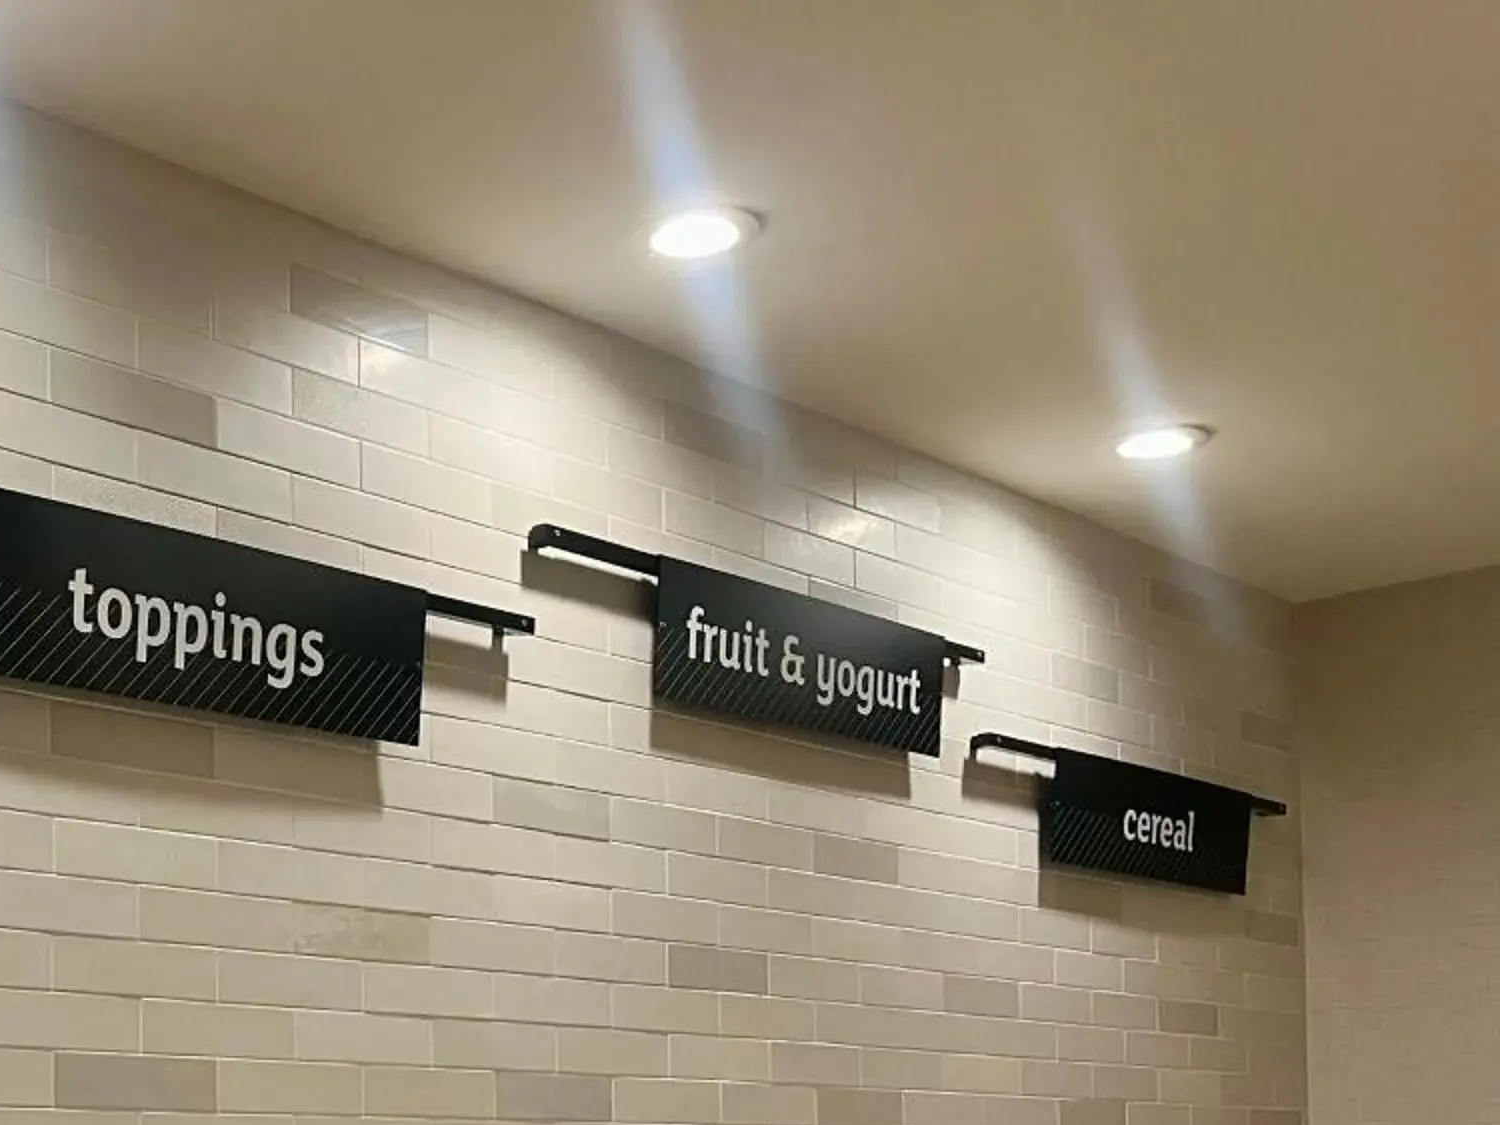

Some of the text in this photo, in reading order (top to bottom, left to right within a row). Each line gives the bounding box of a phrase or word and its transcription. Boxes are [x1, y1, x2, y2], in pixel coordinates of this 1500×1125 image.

[68, 567, 325, 689] toppings
[686, 605, 921, 716] fruit & yogurt
[1123, 809, 1196, 852] cereal
